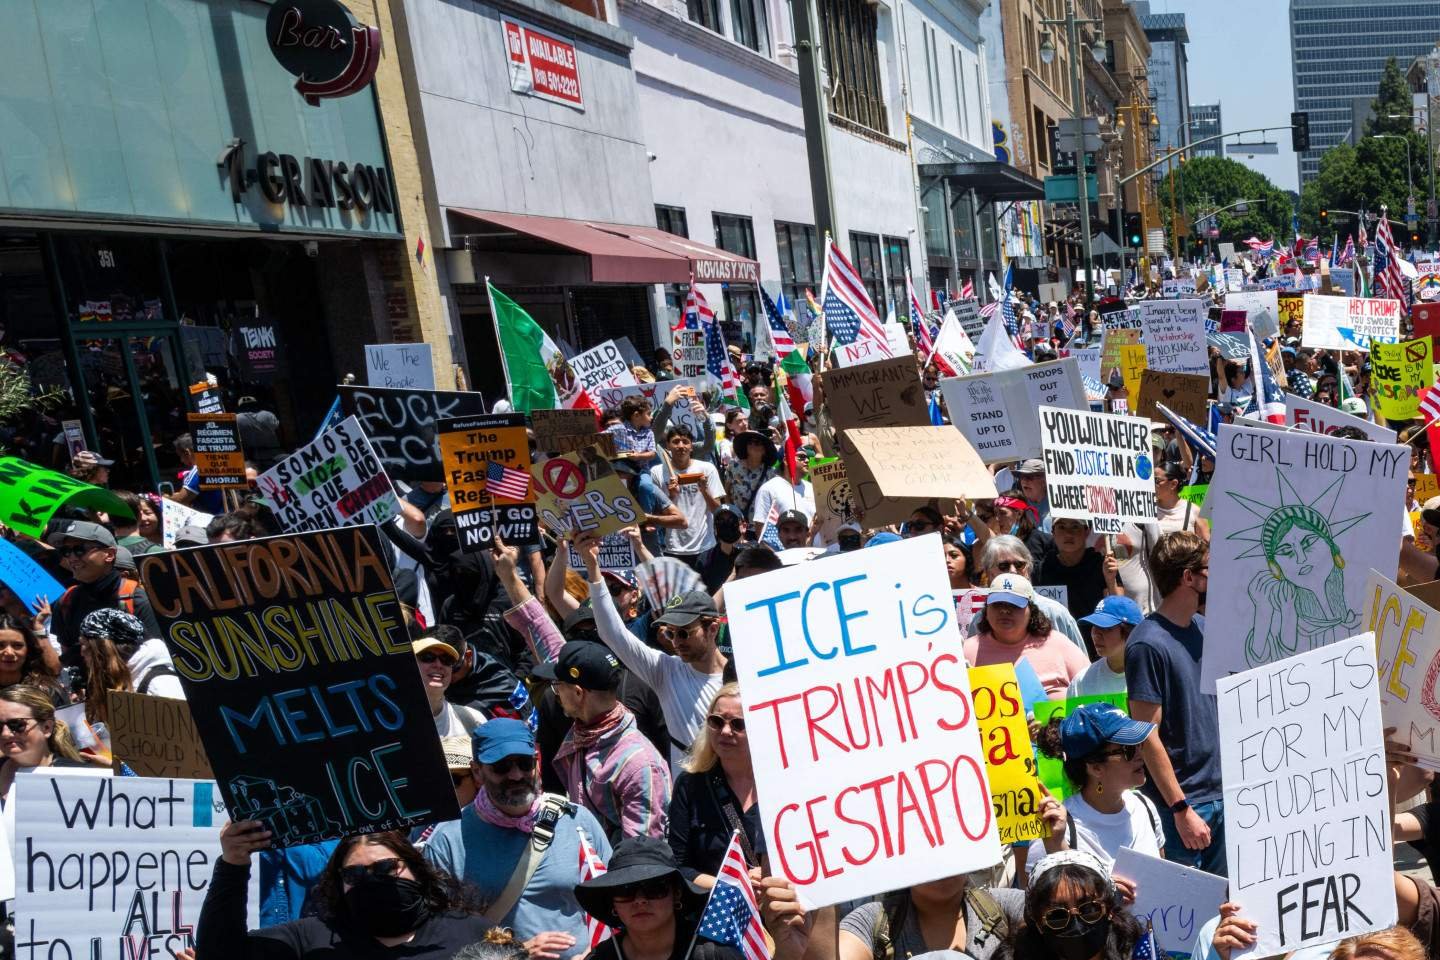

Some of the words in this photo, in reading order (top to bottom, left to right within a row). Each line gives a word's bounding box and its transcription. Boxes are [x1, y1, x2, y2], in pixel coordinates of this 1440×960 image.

[530, 36, 575, 70] AVAILABLE
[257, 151, 392, 214] GRAYSON
[1350, 316, 1365, 325] YOU
[1367, 317, 1395, 327] SWORE
[830, 364, 919, 389] IMMIGRANTS
[1027, 367, 1064, 381] TROOPS
[1039, 381, 1058, 392] OUT
[353, 391, 460, 433] FUCK
[849, 392, 891, 415] WE
[970, 409, 1004, 422] STAND
[1046, 394, 1059, 404] OF
[196, 437, 236, 445] FASCISTA
[467, 432, 498, 444] The
[976, 425, 990, 436] UP
[991, 424, 1006, 436] TO
[977, 438, 1012, 450] BULLIES
[1043, 411, 1077, 446] YOU
[1076, 414, 1110, 448] WILL
[1108, 418, 1150, 452] NEVER
[454, 448, 516, 464] Trump
[1044, 450, 1075, 475] FIND
[1075, 450, 1110, 477] JUSTICE
[1112, 456, 1124, 477] IN
[1125, 456, 1136, 478] A
[1230, 432, 1294, 469] GIRL,
[1304, 440, 1358, 473] HOLD
[1368, 447, 1406, 479] MY
[456, 509, 501, 528] MUST
[507, 507, 534, 520] GO
[466, 522, 531, 546] NOW!!!
[1094, 517, 1122, 534] RULES
[141, 529, 392, 618] CALIFORNIA
[168, 592, 412, 682] SUNSHINE
[745, 574, 878, 678] ICE
[894, 582, 949, 639] is
[1368, 584, 1428, 702] ICE
[749, 640, 971, 770] TRUMP'S
[1224, 670, 1312, 725] THIS
[1322, 644, 1375, 695] IS
[219, 673, 406, 754] MELTS
[1240, 723, 1305, 780] FOR
[1322, 697, 1369, 750] MY
[51, 776, 185, 830] What
[326, 744, 430, 826] ICE
[1236, 754, 1384, 830] STUDENTS
[774, 753, 992, 887] GESTAPO
[1236, 825, 1336, 891] LIVING
[1344, 810, 1387, 863] IN
[123, 888, 194, 937] ALL
[1276, 872, 1374, 948] FEAR
